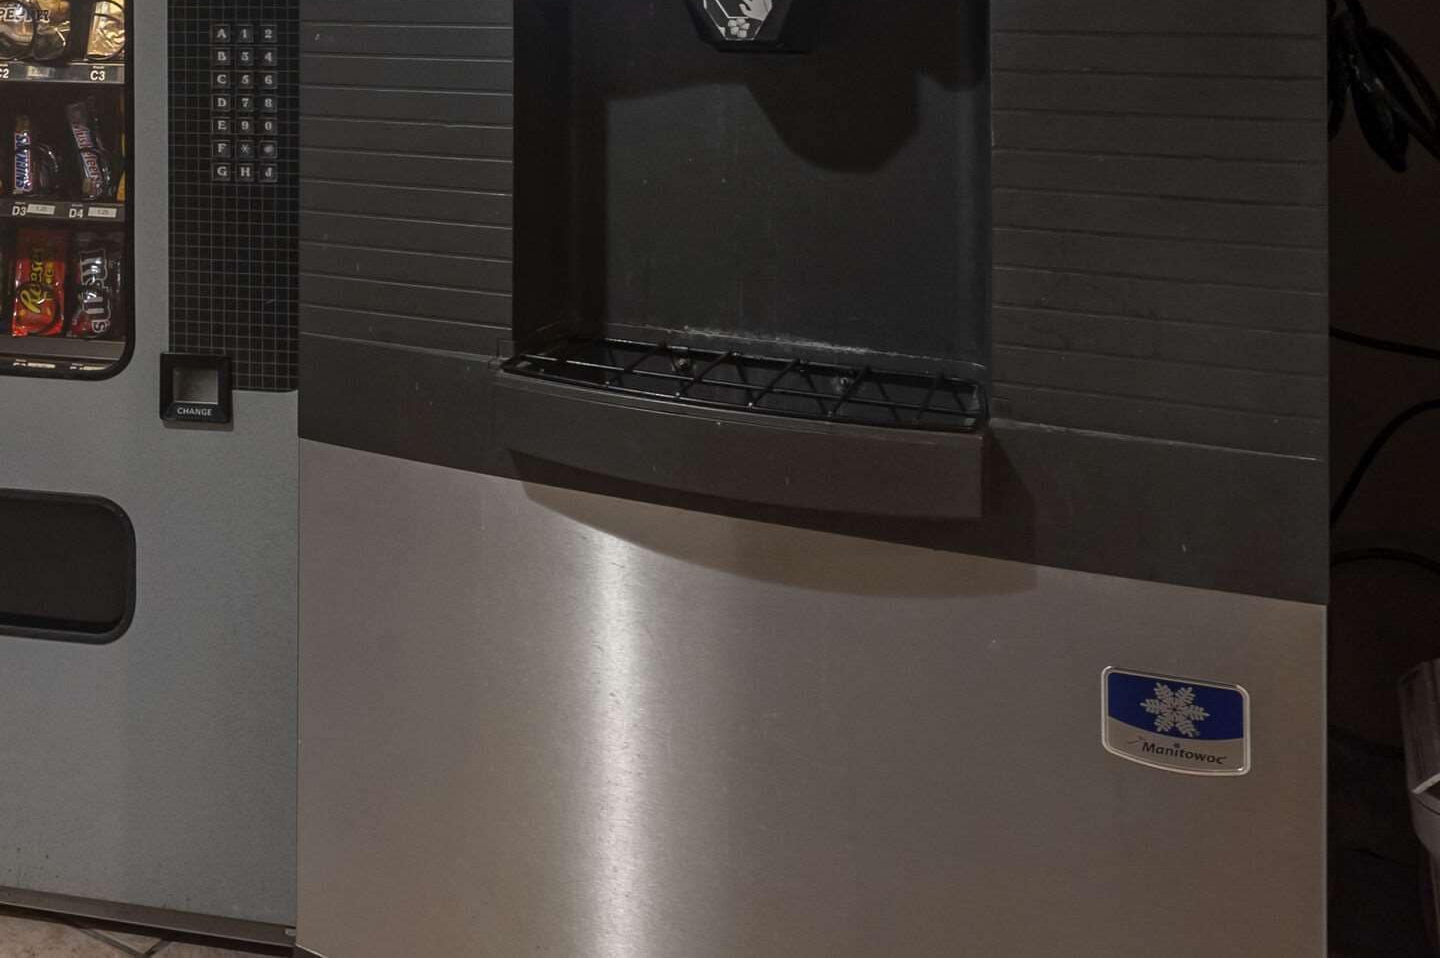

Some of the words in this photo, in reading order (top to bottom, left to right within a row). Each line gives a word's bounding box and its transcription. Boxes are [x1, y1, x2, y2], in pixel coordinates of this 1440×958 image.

[216, 28, 227, 38] A
[264, 28, 272, 38] 2
[217, 51, 227, 61] B
[264, 51, 272, 61] 4
[90, 70, 106, 80] C3
[216, 74, 227, 84] C
[264, 74, 272, 84] 6
[217, 97, 227, 107] D
[242, 97, 249, 107] 7
[264, 97, 272, 107] 8
[217, 120, 227, 130] E
[241, 120, 249, 130] 9
[217, 143, 227, 153] F
[216, 166, 227, 176] G
[241, 166, 250, 176] H
[12, 205, 27, 216] D3
[69, 208, 84, 218] D4
[176, 406, 213, 417] CHANGE
[1141, 741, 1227, 765] Manitowoc
